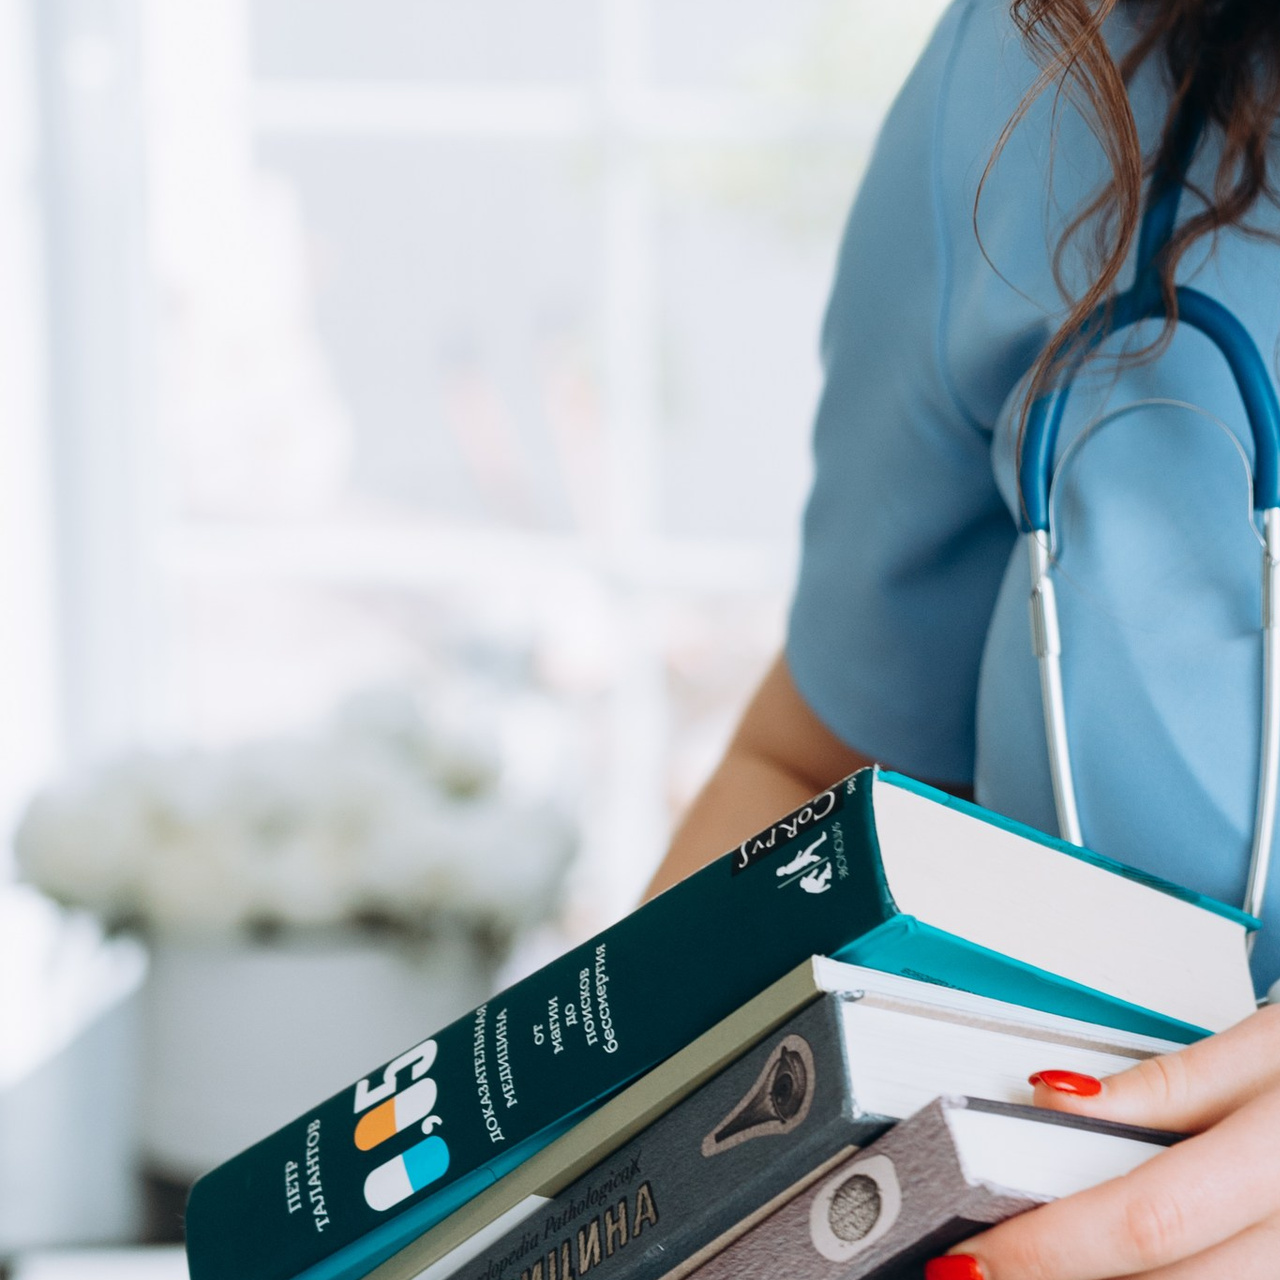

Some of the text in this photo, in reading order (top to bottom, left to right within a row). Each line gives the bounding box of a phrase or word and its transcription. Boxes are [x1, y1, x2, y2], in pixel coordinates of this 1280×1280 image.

[533, 1025, 543, 1044] от
[549, 997, 563, 1054] магии
[565, 1004, 577, 1026] до
[580, 968, 597, 1045] поисков
[596, 944, 618, 1053] бессмертия
[474, 1005, 504, 1143] ДОКАЗАТЕЛЬНАЯ
[496, 1008, 517, 1107] МЕДИЦИНА
[286, 1161, 301, 1213] ПЕТР
[307, 1119, 330, 1232] ТАЛАНТОВ
